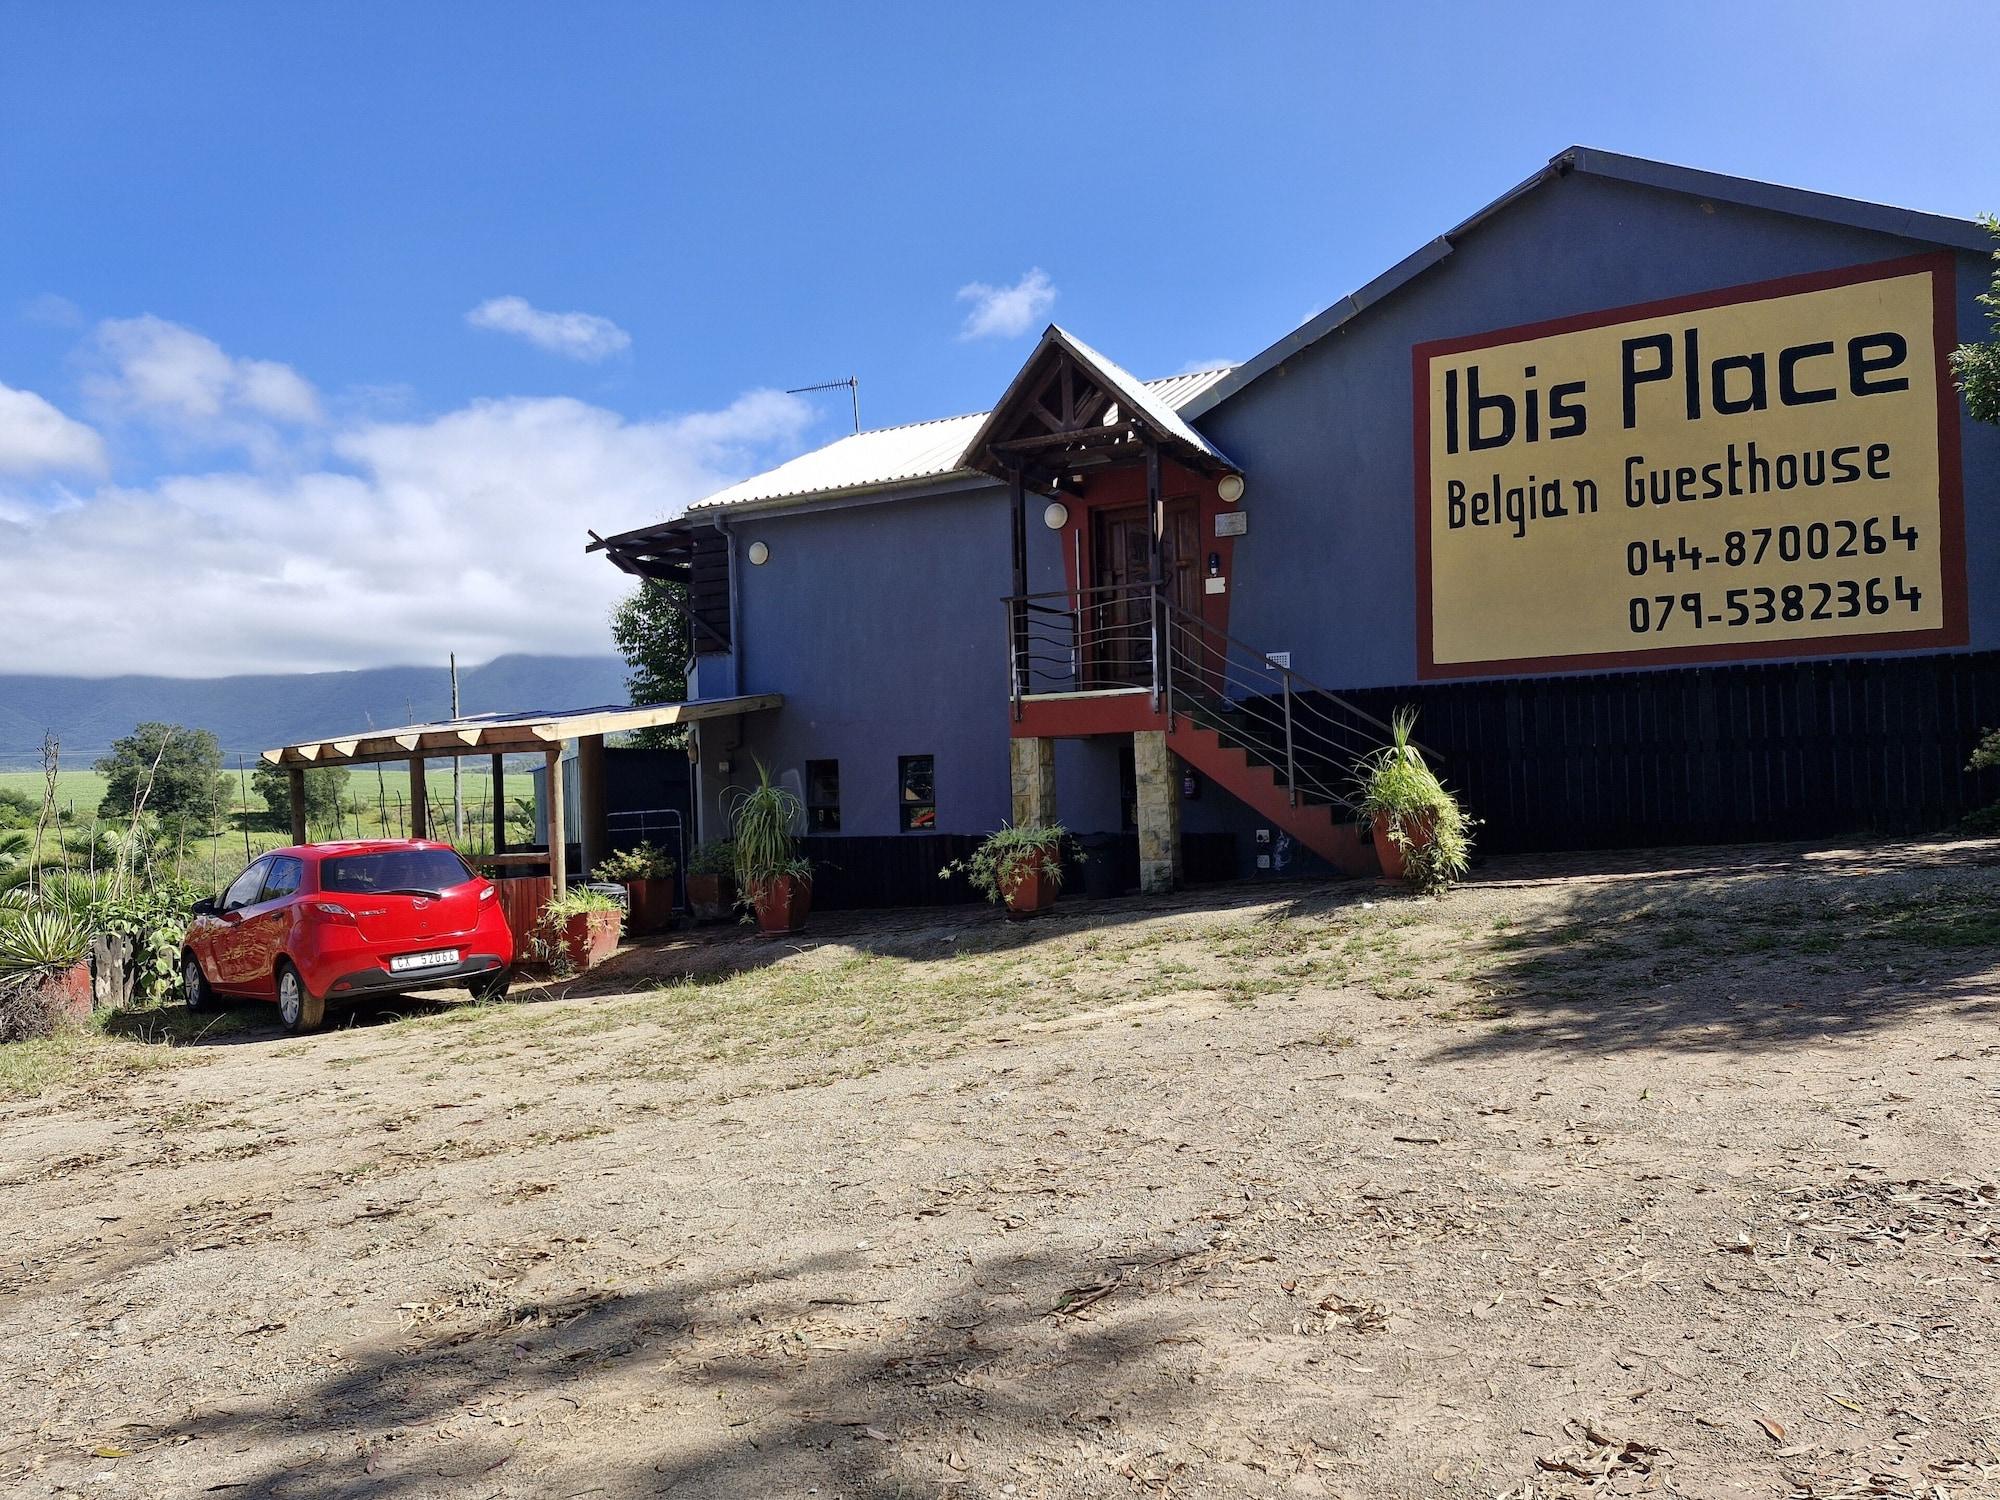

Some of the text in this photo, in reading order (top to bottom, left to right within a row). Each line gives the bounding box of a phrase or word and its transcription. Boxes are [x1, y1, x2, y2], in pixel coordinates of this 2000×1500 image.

[1445, 327, 1910, 454] Ibis Place
[1447, 442, 1891, 538] Belgian Guesthouse
[1627, 516, 1919, 577] 044-8700264
[1629, 575, 1922, 634] 079-5382364
